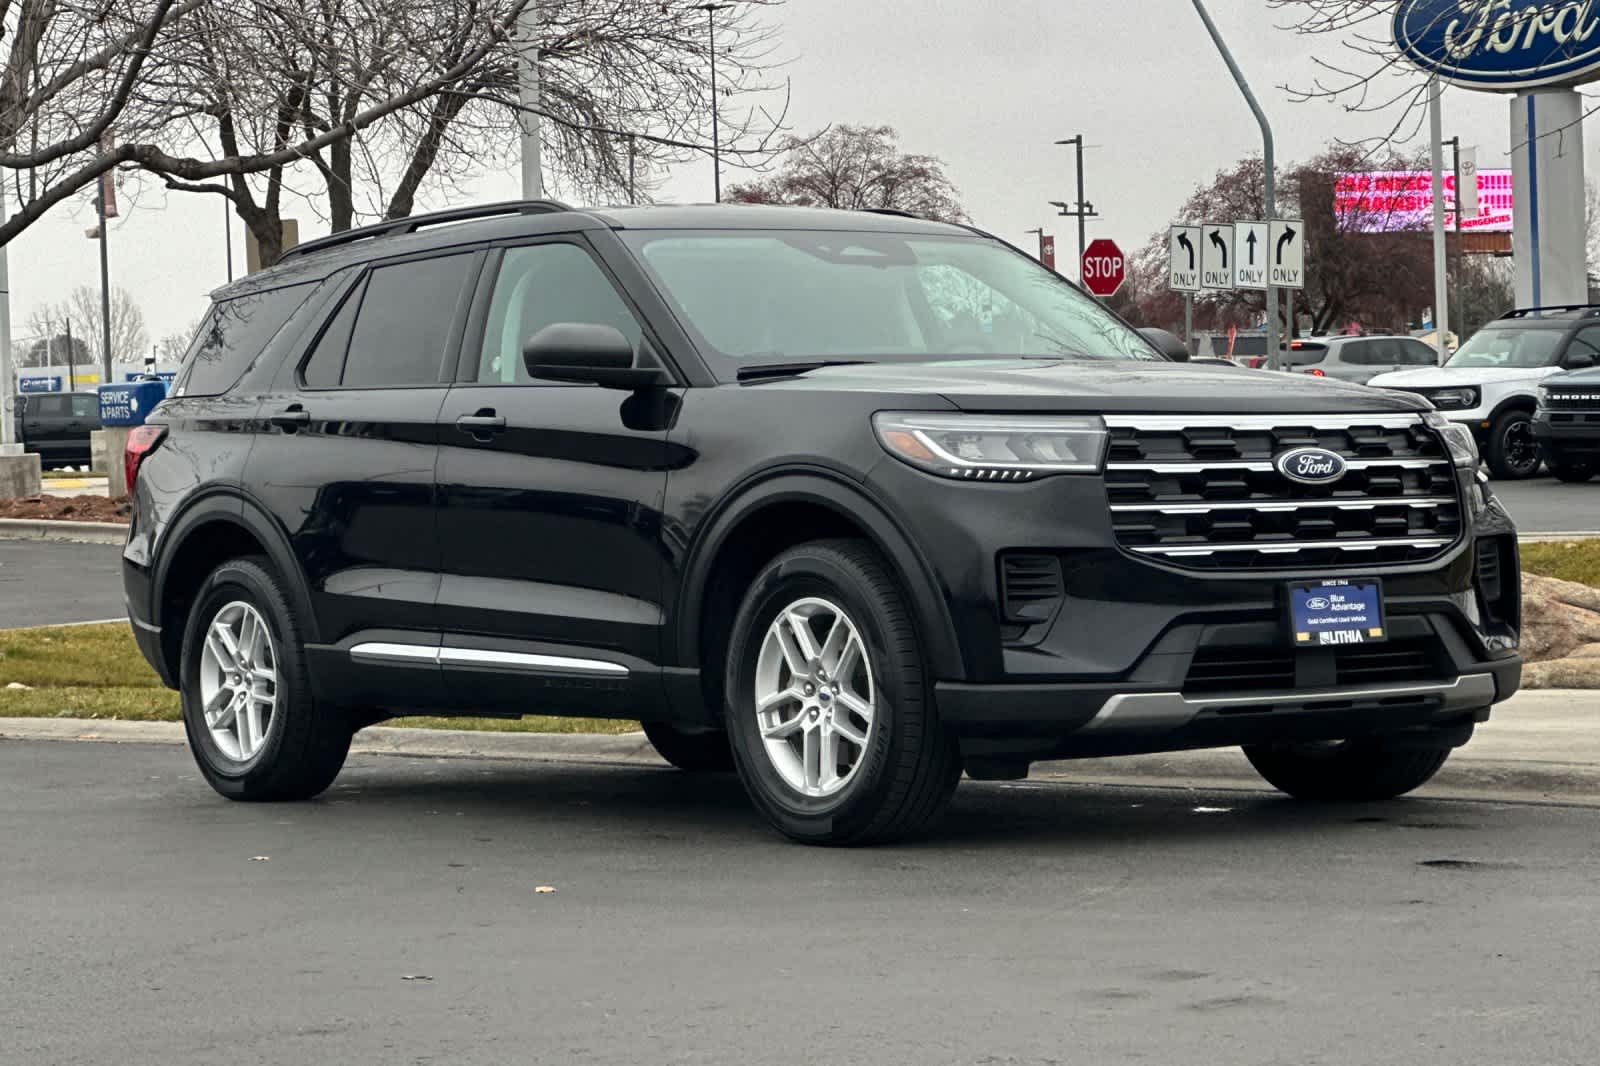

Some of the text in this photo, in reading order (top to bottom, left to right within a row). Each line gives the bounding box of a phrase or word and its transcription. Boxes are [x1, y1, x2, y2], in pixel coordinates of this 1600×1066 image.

[1445, 0, 1600, 59] Ford
[1458, 214, 1512, 229] MERGENCIES
[1084, 256, 1122, 278] STOP
[1173, 272, 1197, 287] ONLY
[1205, 271, 1230, 285] ONLY
[1239, 269, 1263, 283] ONLY
[1273, 268, 1298, 283] ONLY
[100, 391, 129, 405] SERVICE
[1297, 454, 1334, 475] Ford
[1330, 594, 1345, 602] Blue
[1331, 603, 1365, 611] Advantage
[1329, 630, 1363, 644] LITHIA
